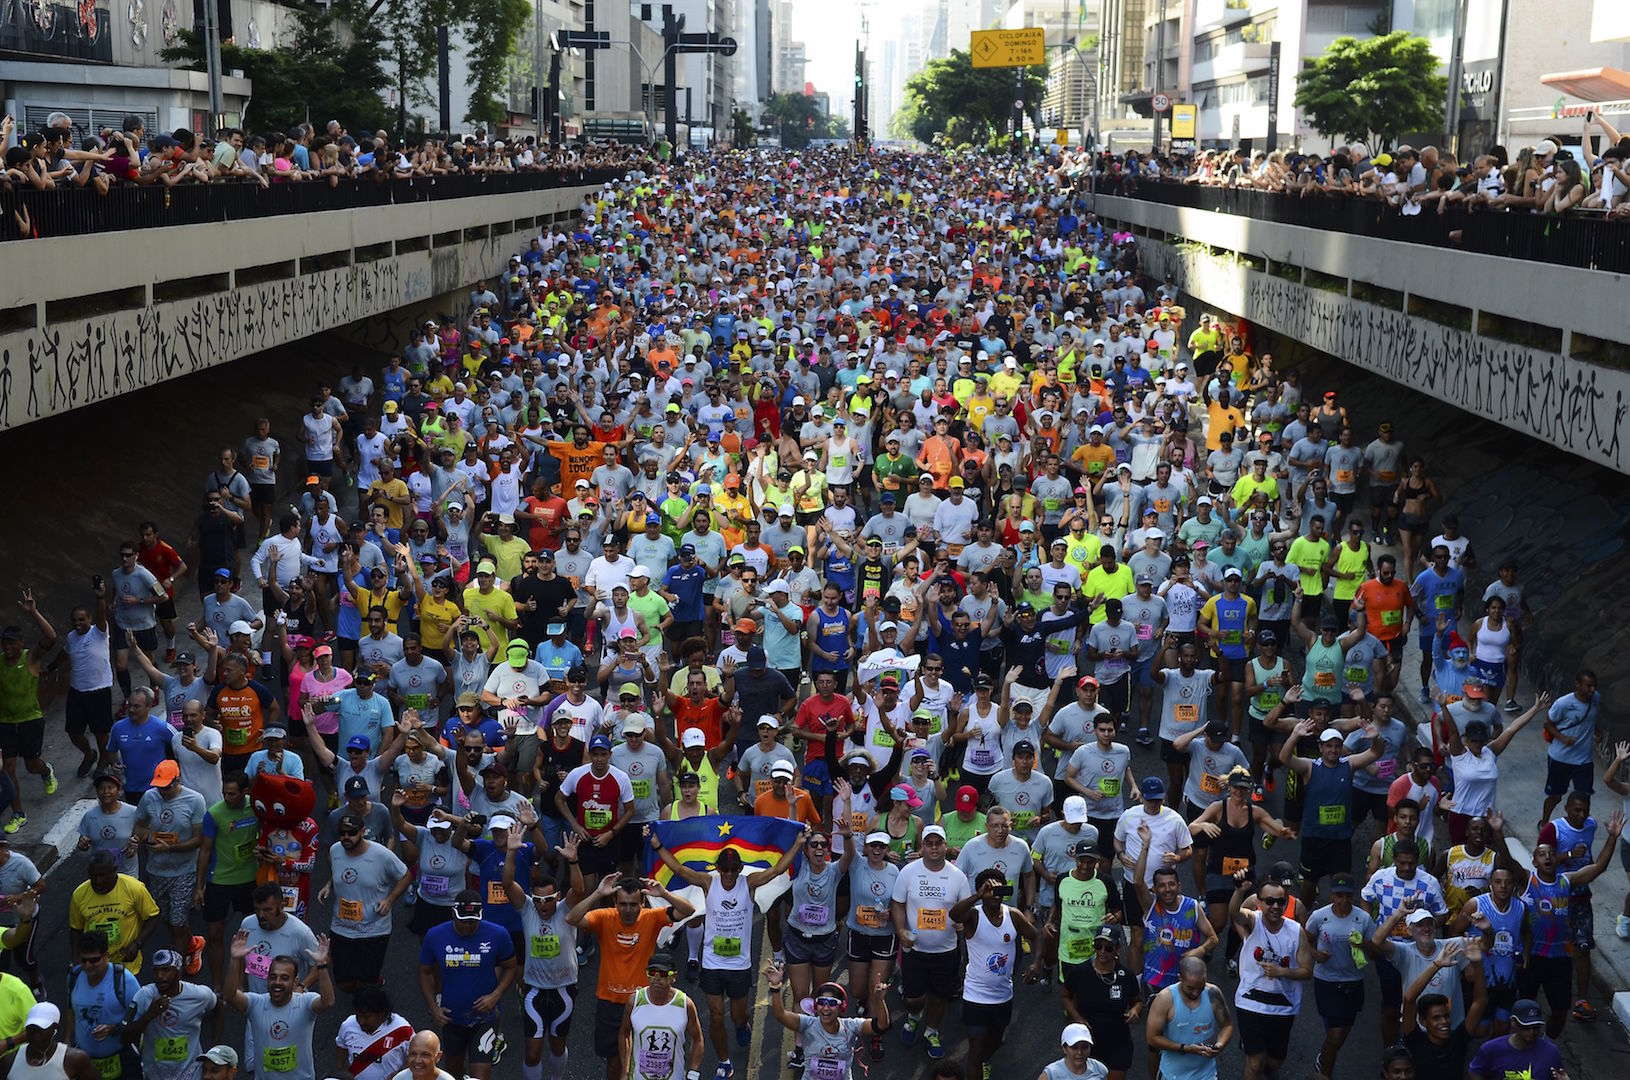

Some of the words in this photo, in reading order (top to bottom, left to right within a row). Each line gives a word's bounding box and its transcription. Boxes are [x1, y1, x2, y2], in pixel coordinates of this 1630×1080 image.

[1155, 97, 1167, 106] 50
[568, 455, 593, 463] MENOS
[1067, 898, 1085, 906] Leva
[162, 1047, 183, 1055] 4542
[271, 1057, 290, 1066] 4357
